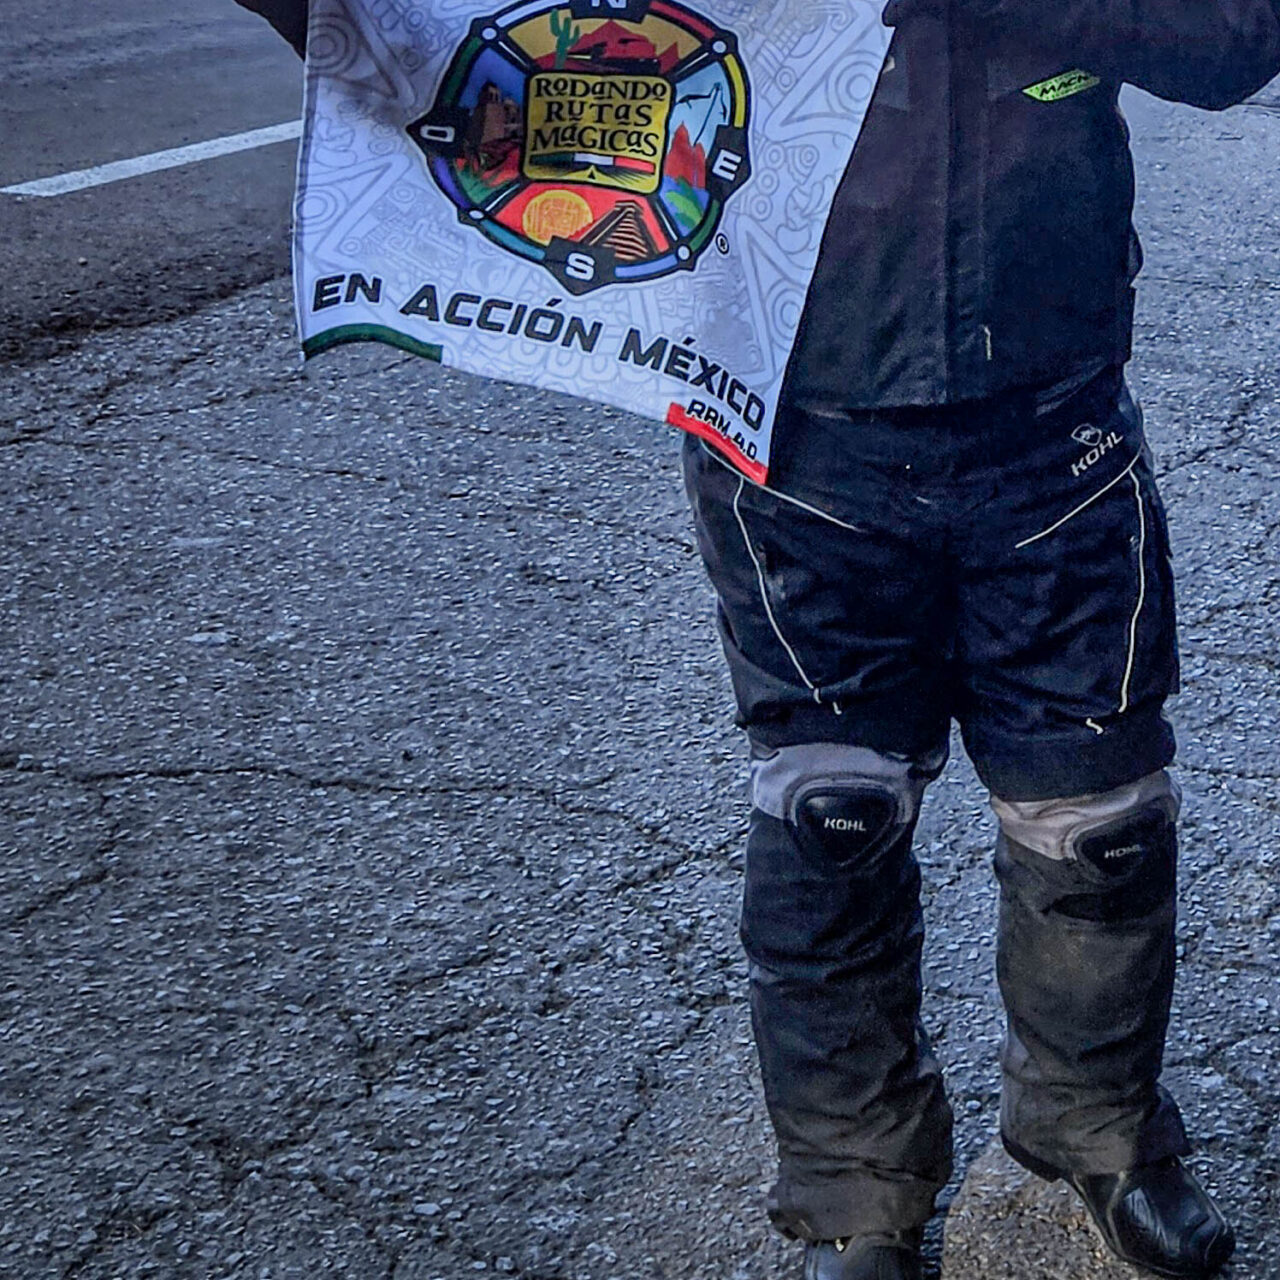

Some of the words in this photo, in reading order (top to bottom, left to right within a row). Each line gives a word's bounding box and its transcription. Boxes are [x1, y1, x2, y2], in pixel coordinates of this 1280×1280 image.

[312, 273, 383, 312] EN
[399, 283, 604, 353] ACCIÓN
[617, 327, 766, 432] MÉXICO
[686, 398, 731, 437] RRM
[1070, 431, 1124, 477] KOHL
[823, 816, 867, 832] KOHL
